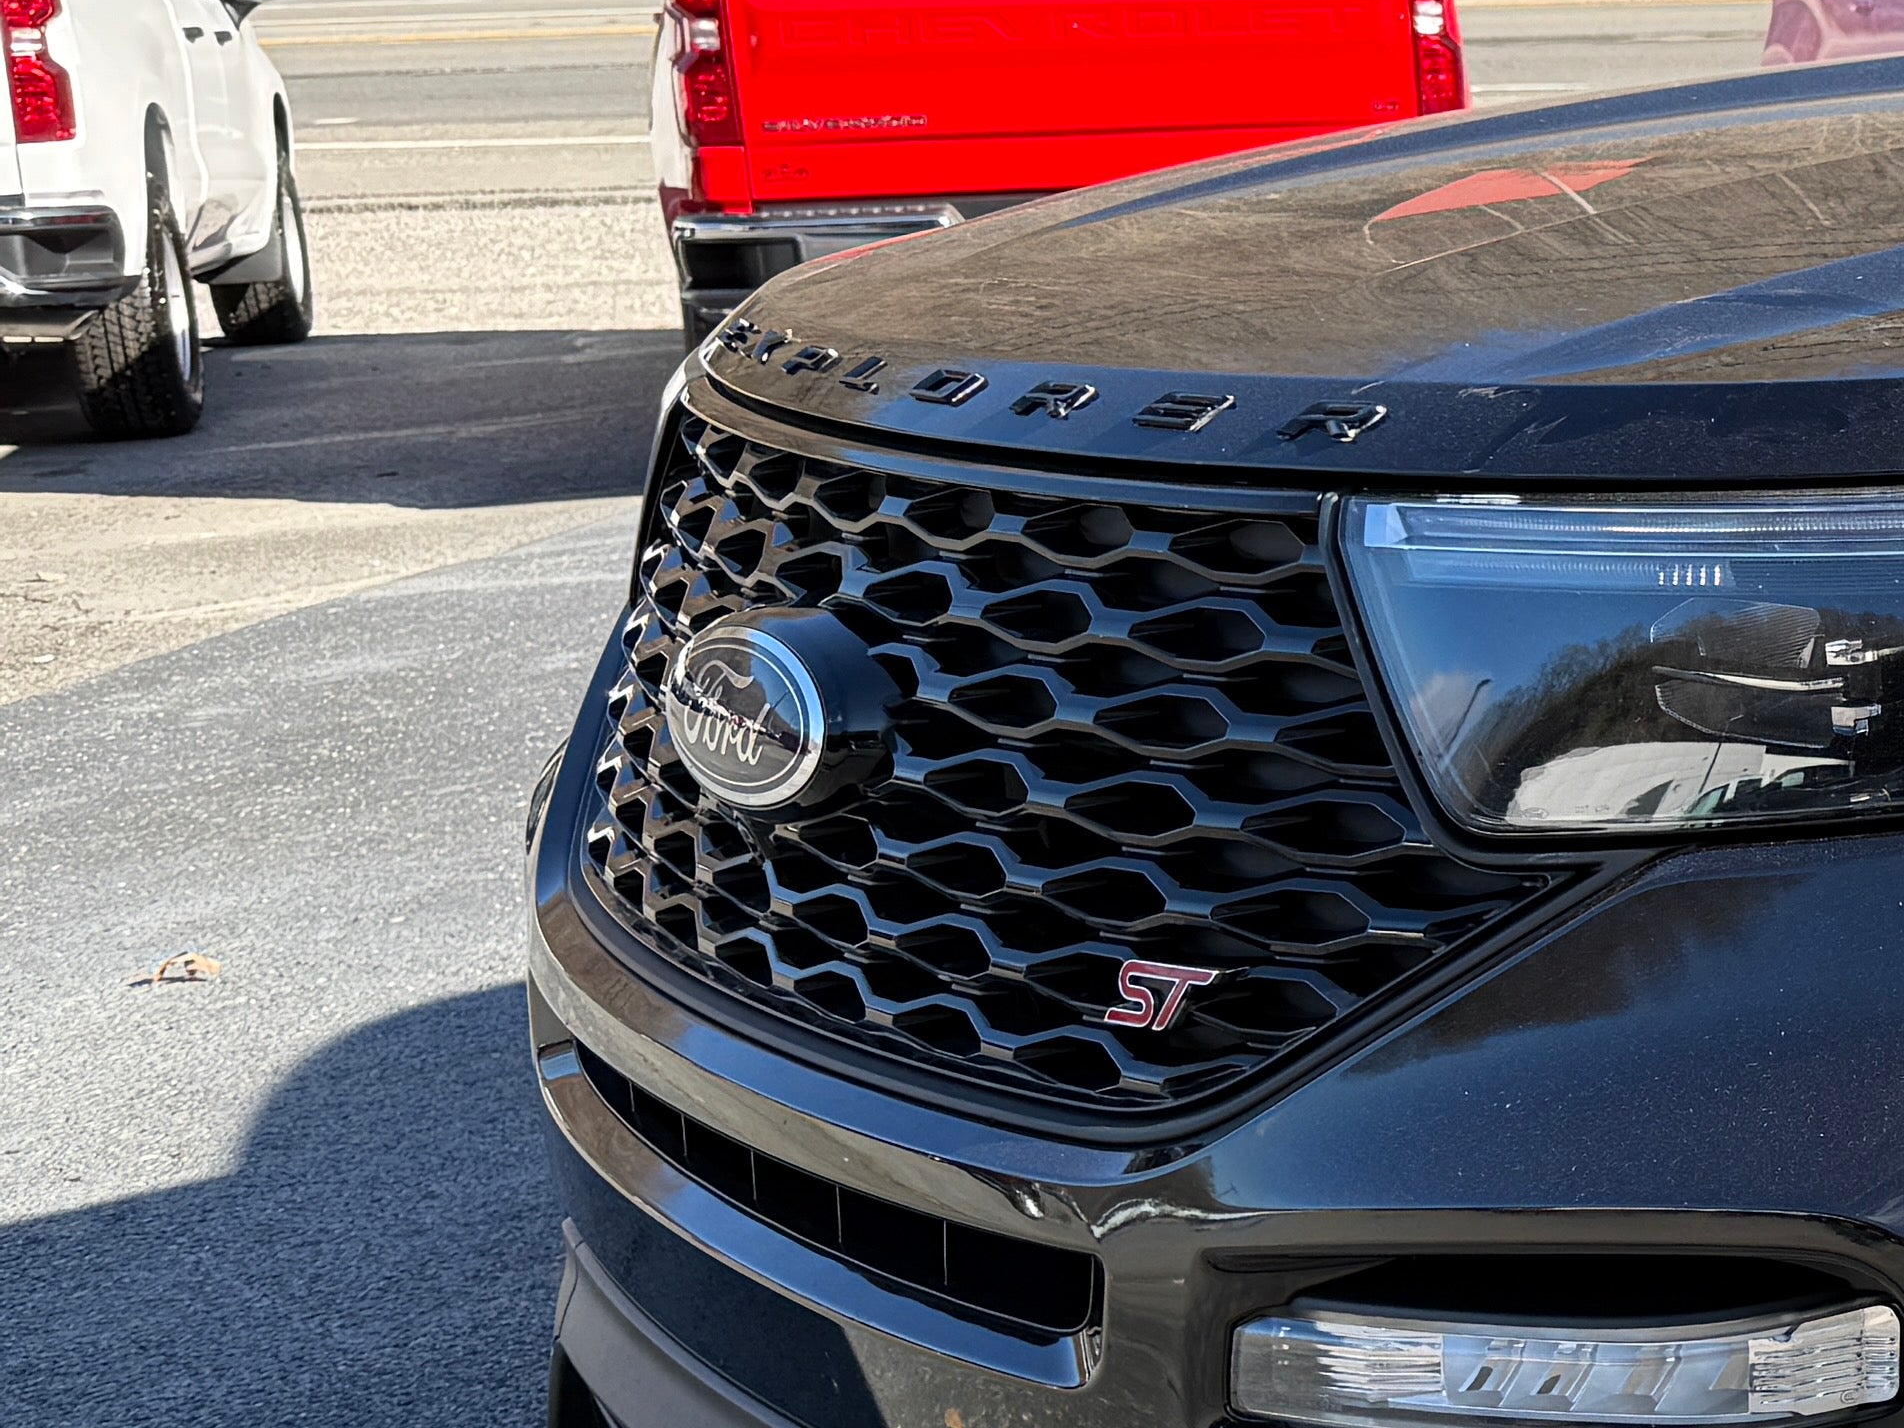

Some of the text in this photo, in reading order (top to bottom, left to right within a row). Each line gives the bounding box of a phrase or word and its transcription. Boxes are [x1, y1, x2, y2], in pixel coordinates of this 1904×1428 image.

[779, 4, 1364, 48] CHEVROLET
[715, 317, 1389, 443] EXPLORER
[684, 659, 771, 766] Ford
[1104, 959, 1220, 1031] ST
